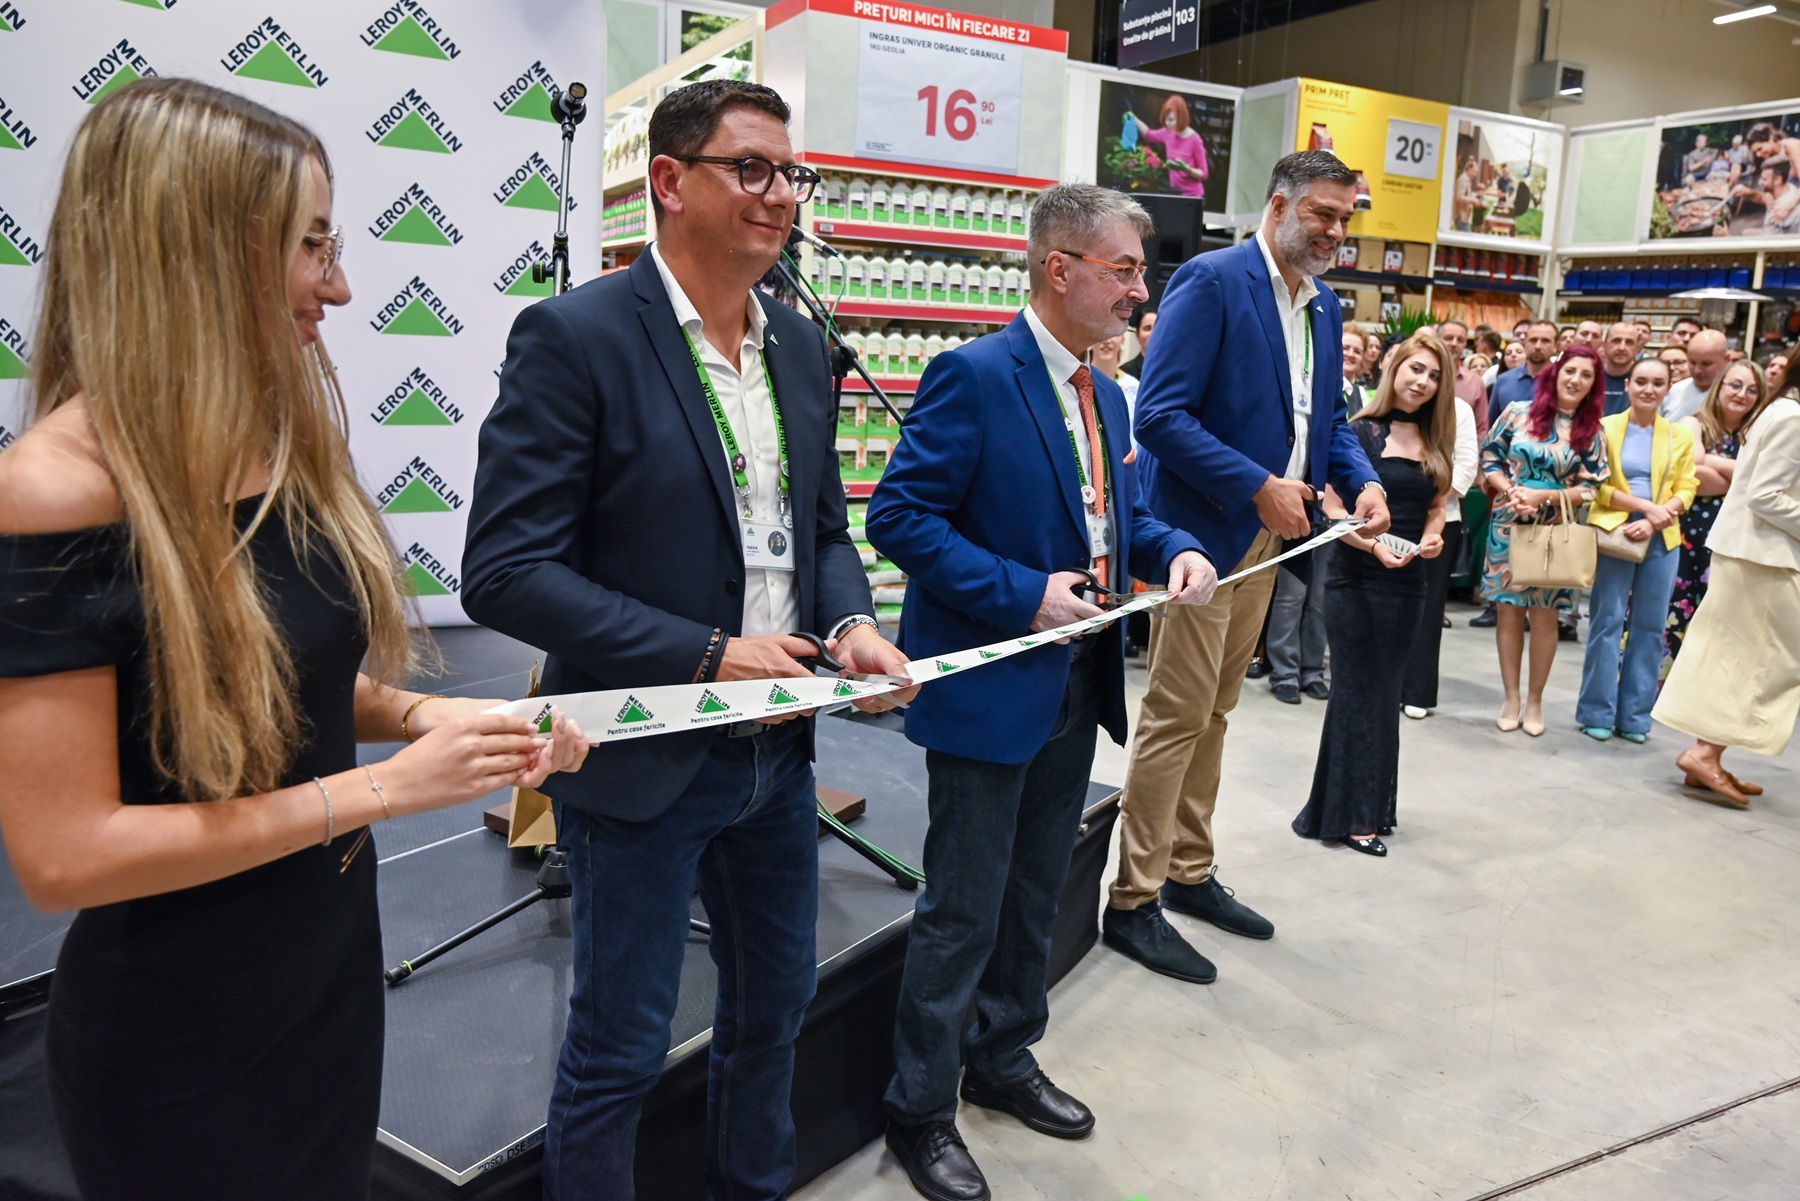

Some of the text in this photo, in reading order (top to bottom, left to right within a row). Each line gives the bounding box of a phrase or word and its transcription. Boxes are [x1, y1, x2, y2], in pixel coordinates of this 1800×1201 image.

[360, 0, 462, 60] LEROY MERLIN
[914, 11, 944, 29] MICI
[946, 13, 961, 31] ÎN
[963, 20, 1015, 39] FIECARE
[1017, 29, 1031, 43] ZI
[1141, 31, 1149, 41] de
[1176, 7, 1196, 26] 103
[221, 16, 329, 88] LEROY MERLIN
[869, 32, 1006, 61] INGRAS UNIVER ORGANIC GRANULE
[870, 43, 905, 55] 1KG GEOLIA
[72, 48, 123, 100] LEROY
[493, 69, 535, 113] LEROY
[1305, 85, 1327, 96] PRIM
[365, 88, 463, 153] LEROY MERLIN
[917, 85, 995, 141] 16 90
[981, 116, 993, 125] Lei
[1395, 136, 1425, 164] 20
[493, 151, 578, 212] LEROY MERLN
[368, 183, 464, 245] LEROY MERLIN
[493, 249, 533, 293] LEROY
[369, 275, 464, 335] LEROY MERLIN
[370, 366, 464, 424] LEROY MERLIN
[702, 382, 737, 451] LEROY MERLIN
[409, 455, 464, 511] MERLIN
[408, 542, 462, 593] MERLIN
[615, 694, 655, 724] LEROY MERLIN
[695, 688, 731, 713] LEROY MERLIN
[773, 683, 799, 702] MERLIN
[607, 728, 628, 736] Pentru
[643, 722, 666, 732] fericite
[690, 716, 710, 724] Pentru
[723, 711, 743, 721] fericite
